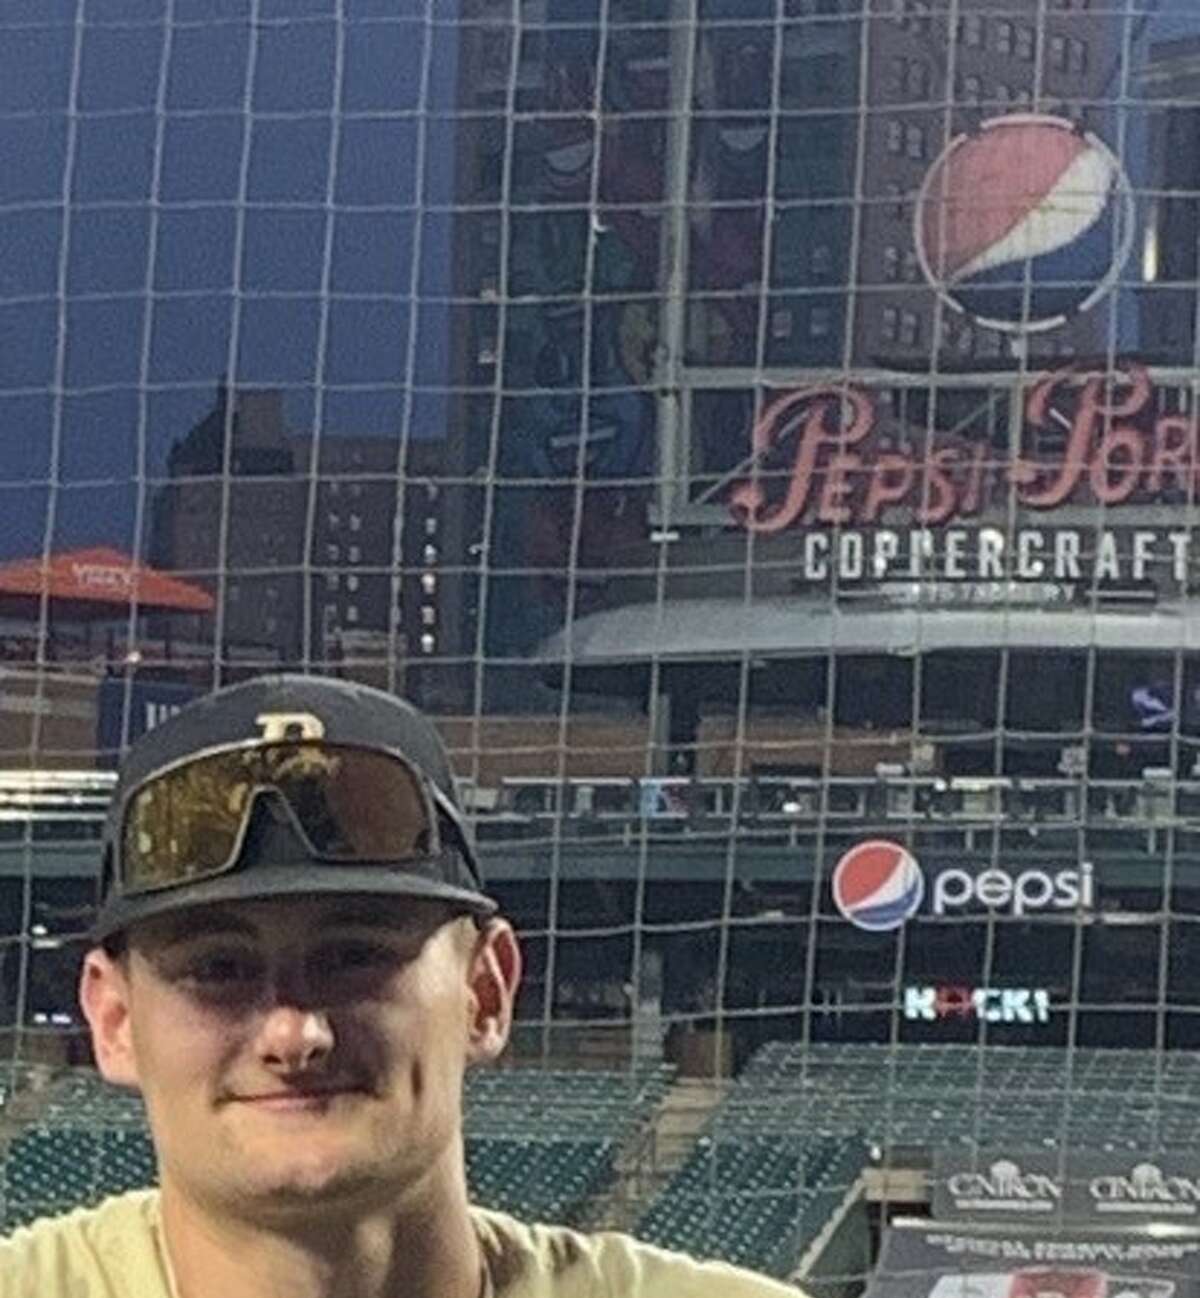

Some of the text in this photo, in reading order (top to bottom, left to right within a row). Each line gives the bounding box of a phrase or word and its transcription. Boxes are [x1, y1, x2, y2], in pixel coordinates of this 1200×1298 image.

[1010, 362, 1200, 506] POR
[804, 528, 1191, 581] COPPERCRAFT
[933, 863, 1094, 915] pepsi
